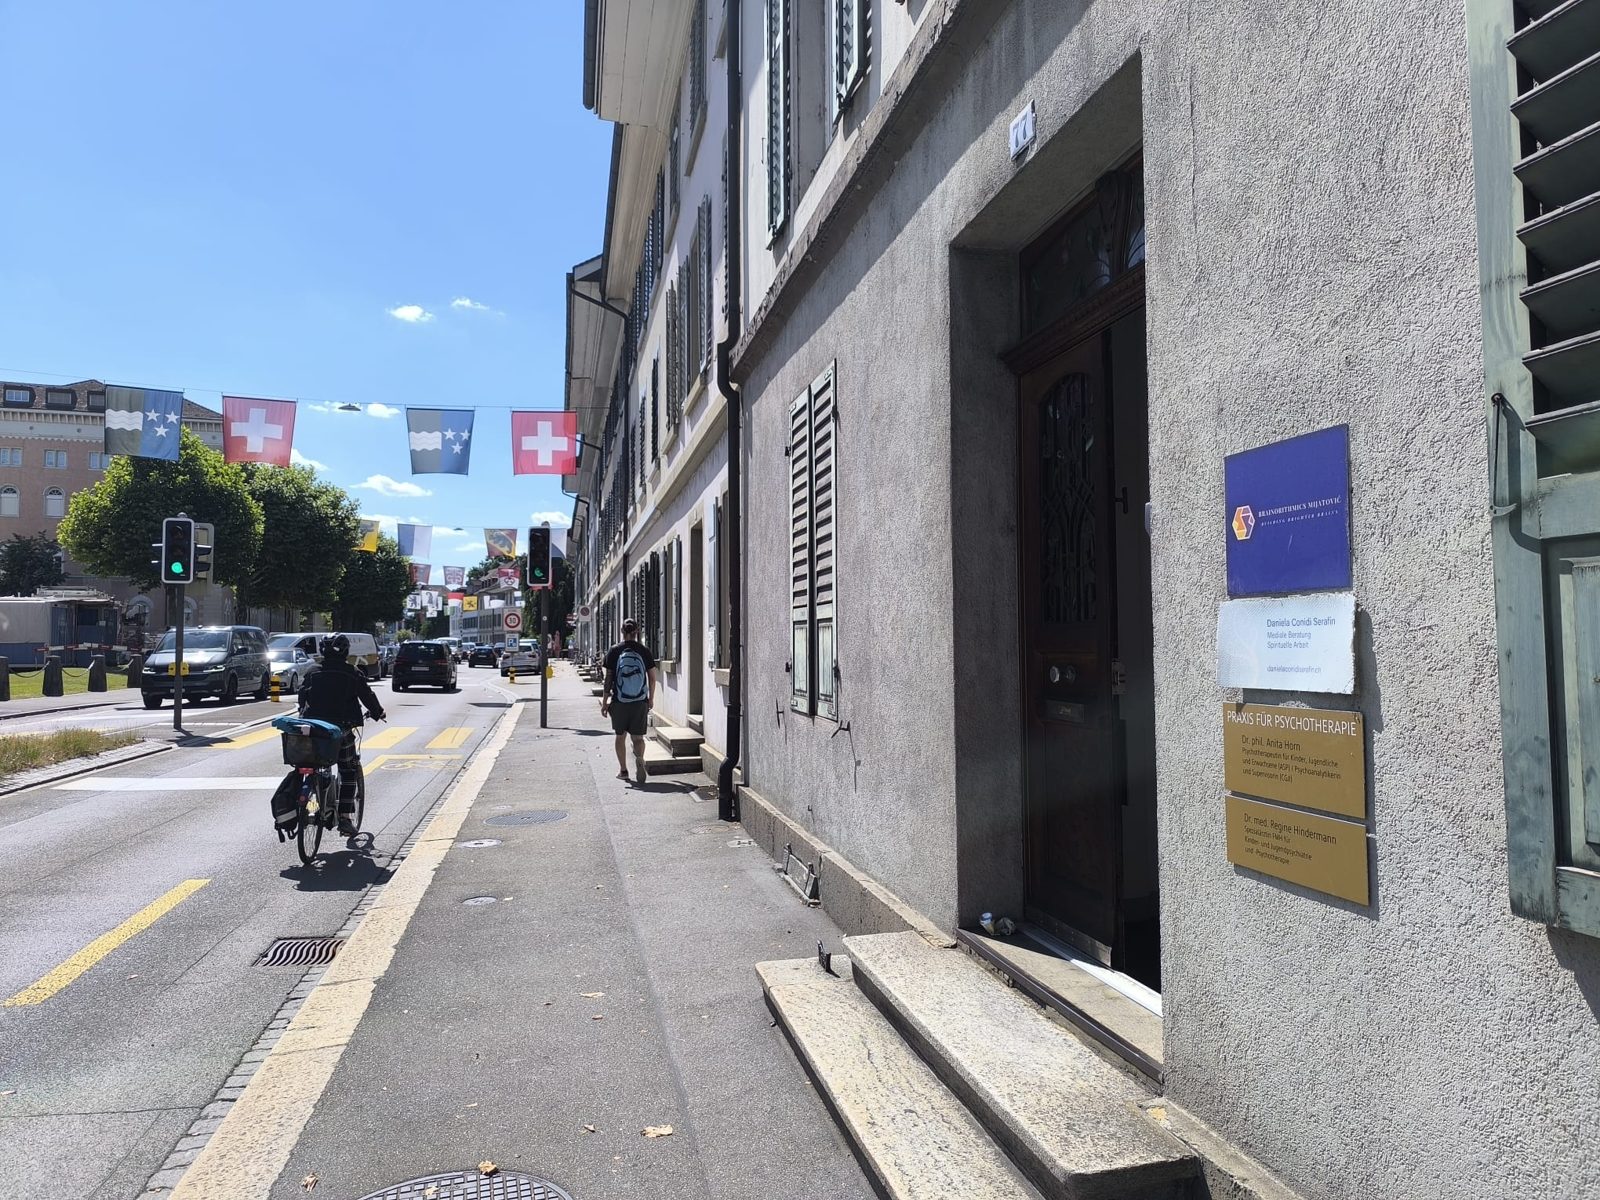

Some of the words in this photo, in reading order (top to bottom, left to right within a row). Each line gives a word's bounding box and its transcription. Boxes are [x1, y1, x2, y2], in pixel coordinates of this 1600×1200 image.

[1013, 112, 1028, 148] 77
[1267, 618, 1290, 627] Daniela
[1291, 617, 1312, 626] Conidi
[1313, 616, 1336, 626] Serafin
[1288, 631, 1311, 639] Beratung
[1267, 641, 1292, 650] Spirituelle
[1227, 711, 1254, 725] PRAXIS
[1256, 712, 1272, 727] FÜR
[1275, 715, 1357, 736] PSYCHOTHERAPIE
[1242, 735, 1250, 744] Dr.
[1252, 736, 1264, 747] phil.
[1266, 738, 1282, 749] Anita
[1285, 740, 1301, 751] Horn
[1308, 756, 1338, 768] Jugendliche
[1244, 813, 1252, 824] Dr.
[1254, 817, 1269, 827] med.
[1271, 819, 1292, 833] Regine
[1293, 825, 1337, 844] Hindermann
